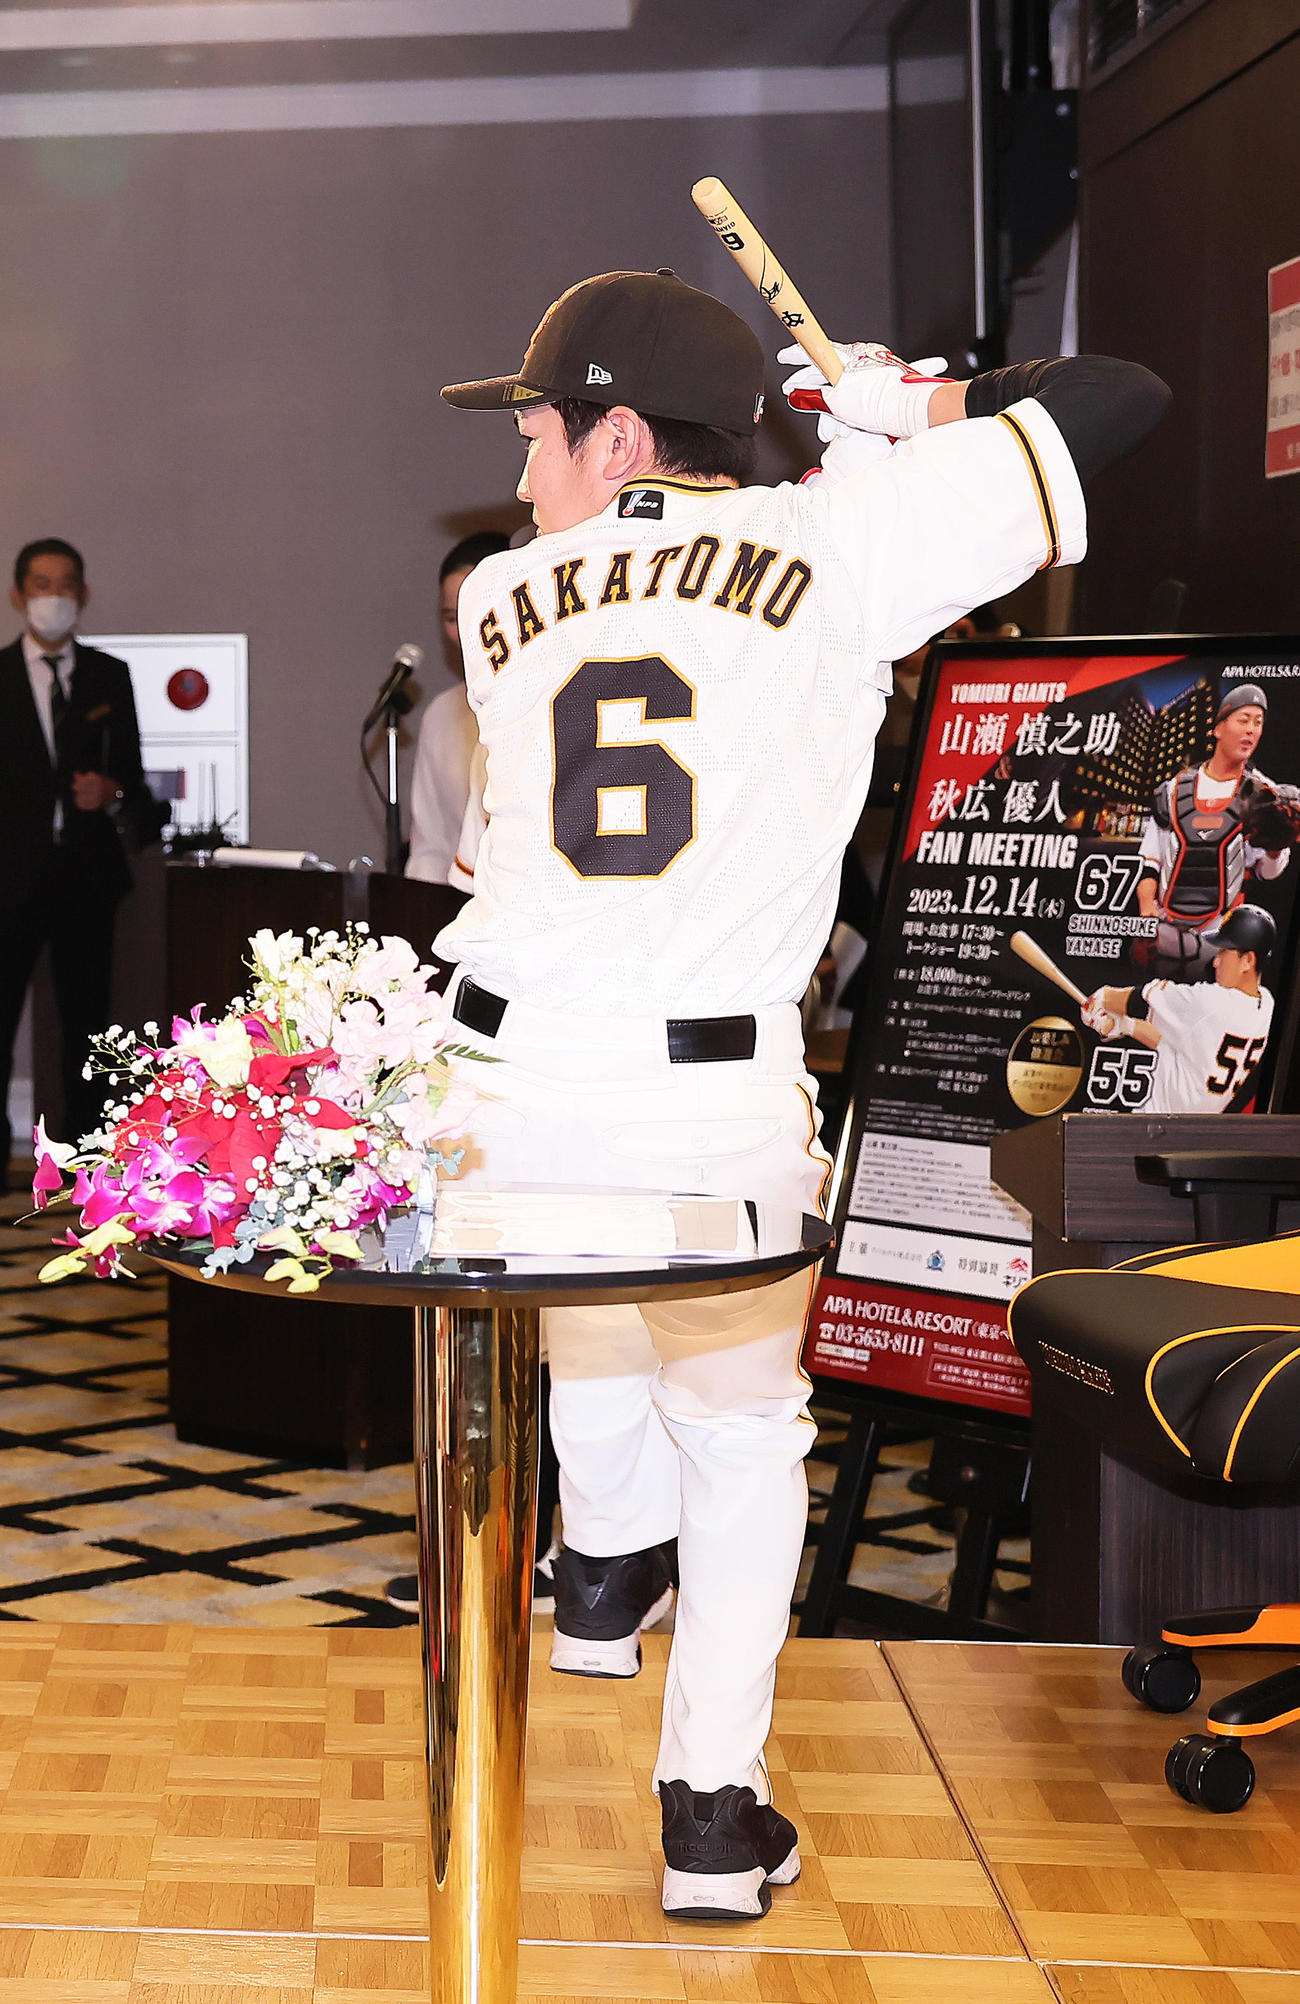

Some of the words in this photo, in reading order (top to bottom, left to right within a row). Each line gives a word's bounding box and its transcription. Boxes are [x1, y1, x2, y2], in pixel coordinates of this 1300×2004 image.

[479, 533, 813, 675] SAKATOMO
[951, 683, 1012, 704] YOMIURI
[1012, 682, 1067, 704] GIANTS
[939, 713, 1010, 755] 山瀬
[1014, 712, 1121, 756] 慎之助
[549, 652, 698, 881] 6
[928, 778, 996, 821] 秋広
[1002, 777, 1067, 824] 優人
[916, 831, 964, 864] FAN
[967, 832, 1078, 869] MEETING
[1074, 854, 1146, 912] 67
[1066, 936, 1122, 958] YAMASE
[1067, 914, 1159, 938] SHINNOSUKE
[1086, 1045, 1159, 1107] 55
[823, 1295, 852, 1317] APA
